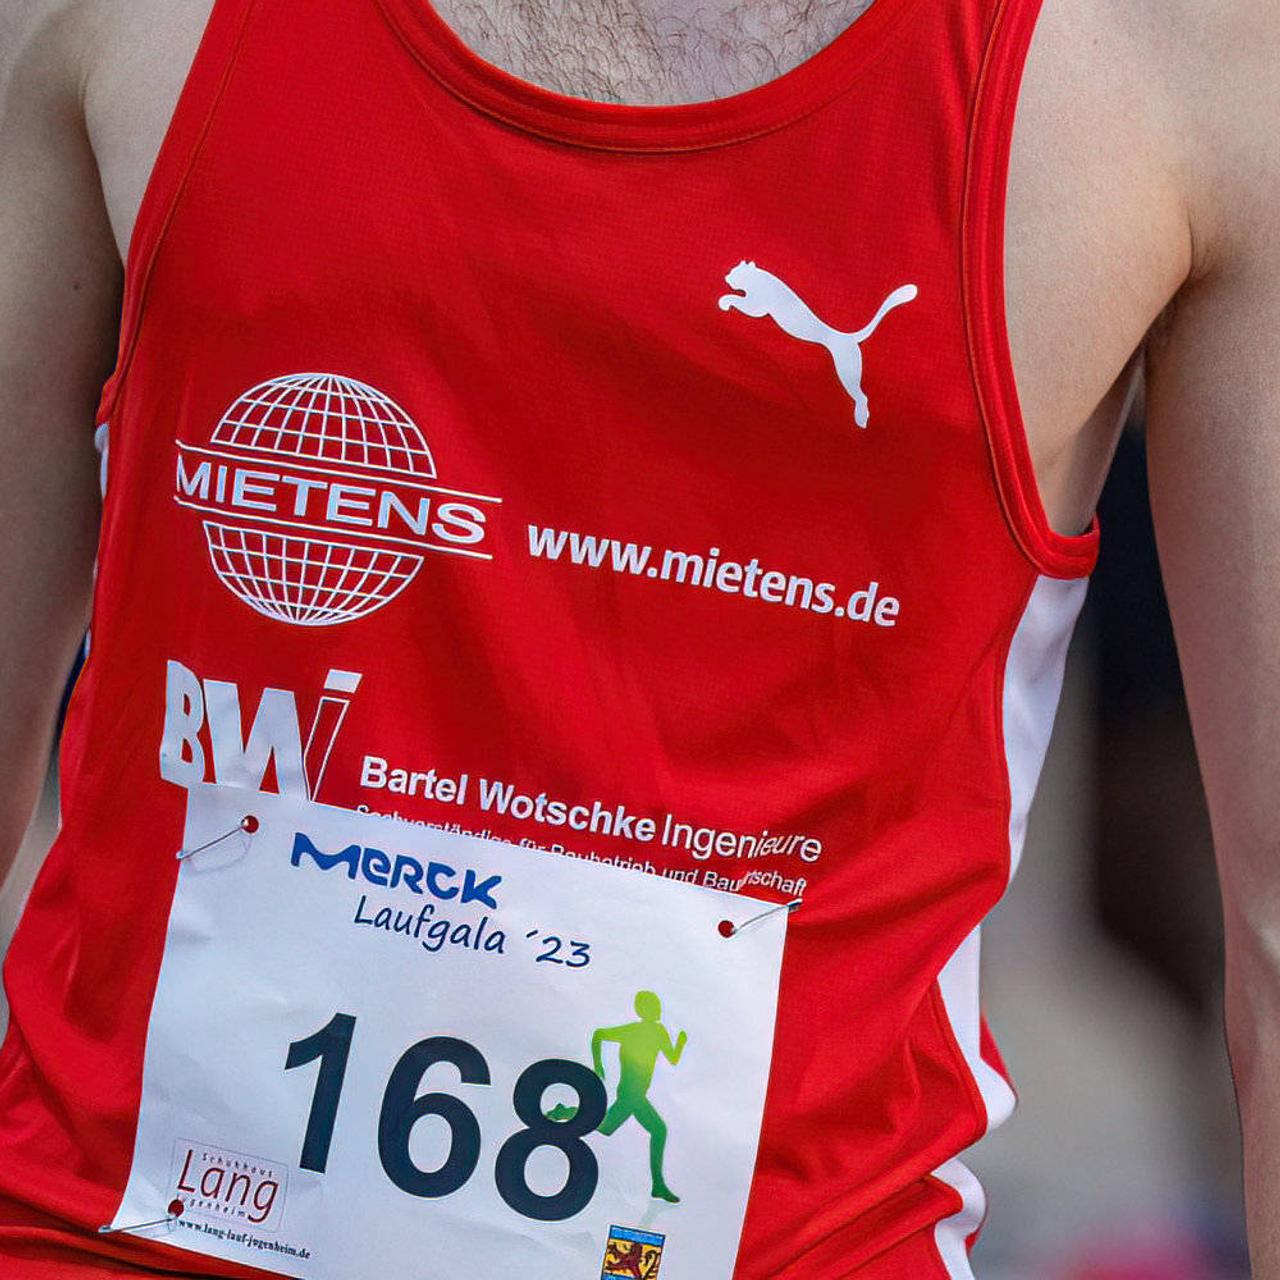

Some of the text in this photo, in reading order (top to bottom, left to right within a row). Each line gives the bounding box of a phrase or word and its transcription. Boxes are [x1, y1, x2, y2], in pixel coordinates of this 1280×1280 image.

[176, 454, 487, 544] MIETENS
[527, 523, 901, 627] www.mietens.de
[360, 755, 823, 862] Bartel Wotschke Ingenieure
[662, 867, 699, 886] und
[353, 895, 506, 953] Laufgala
[283, 1011, 609, 1222] 168
[176, 1149, 279, 1223] Lang
